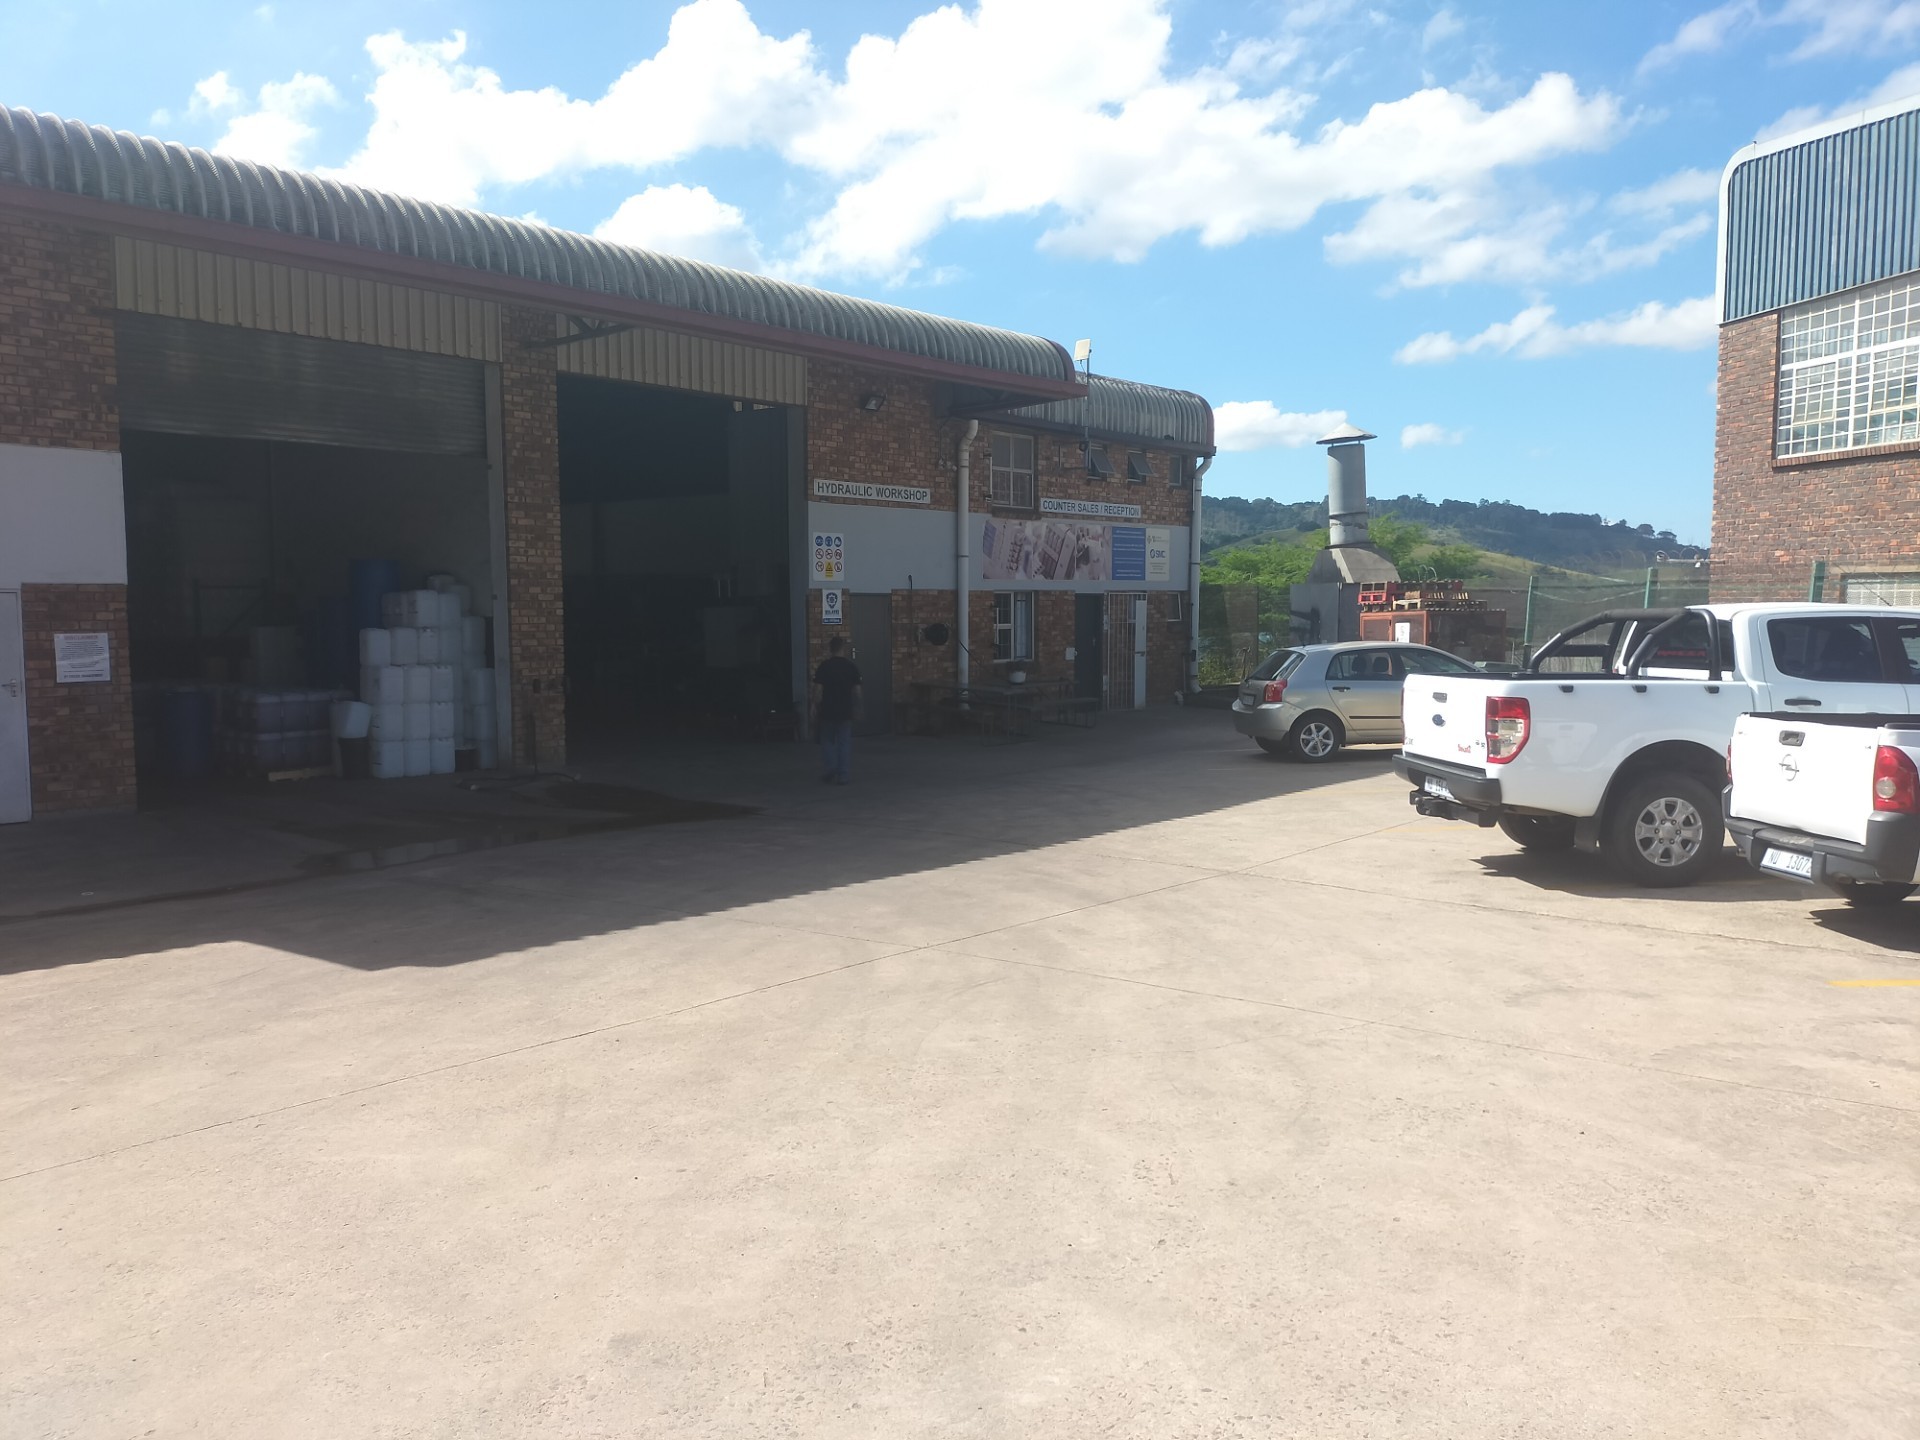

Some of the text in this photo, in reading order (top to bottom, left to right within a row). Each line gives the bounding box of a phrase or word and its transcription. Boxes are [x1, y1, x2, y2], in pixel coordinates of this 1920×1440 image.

[817, 481, 928, 501] HYDRAULIC WORKSHOP
[1042, 500, 1076, 512] COUNTER
[1077, 503, 1099, 514] SALES
[1104, 505, 1140, 517] RECEPTION
[1769, 850, 1782, 865] NU
